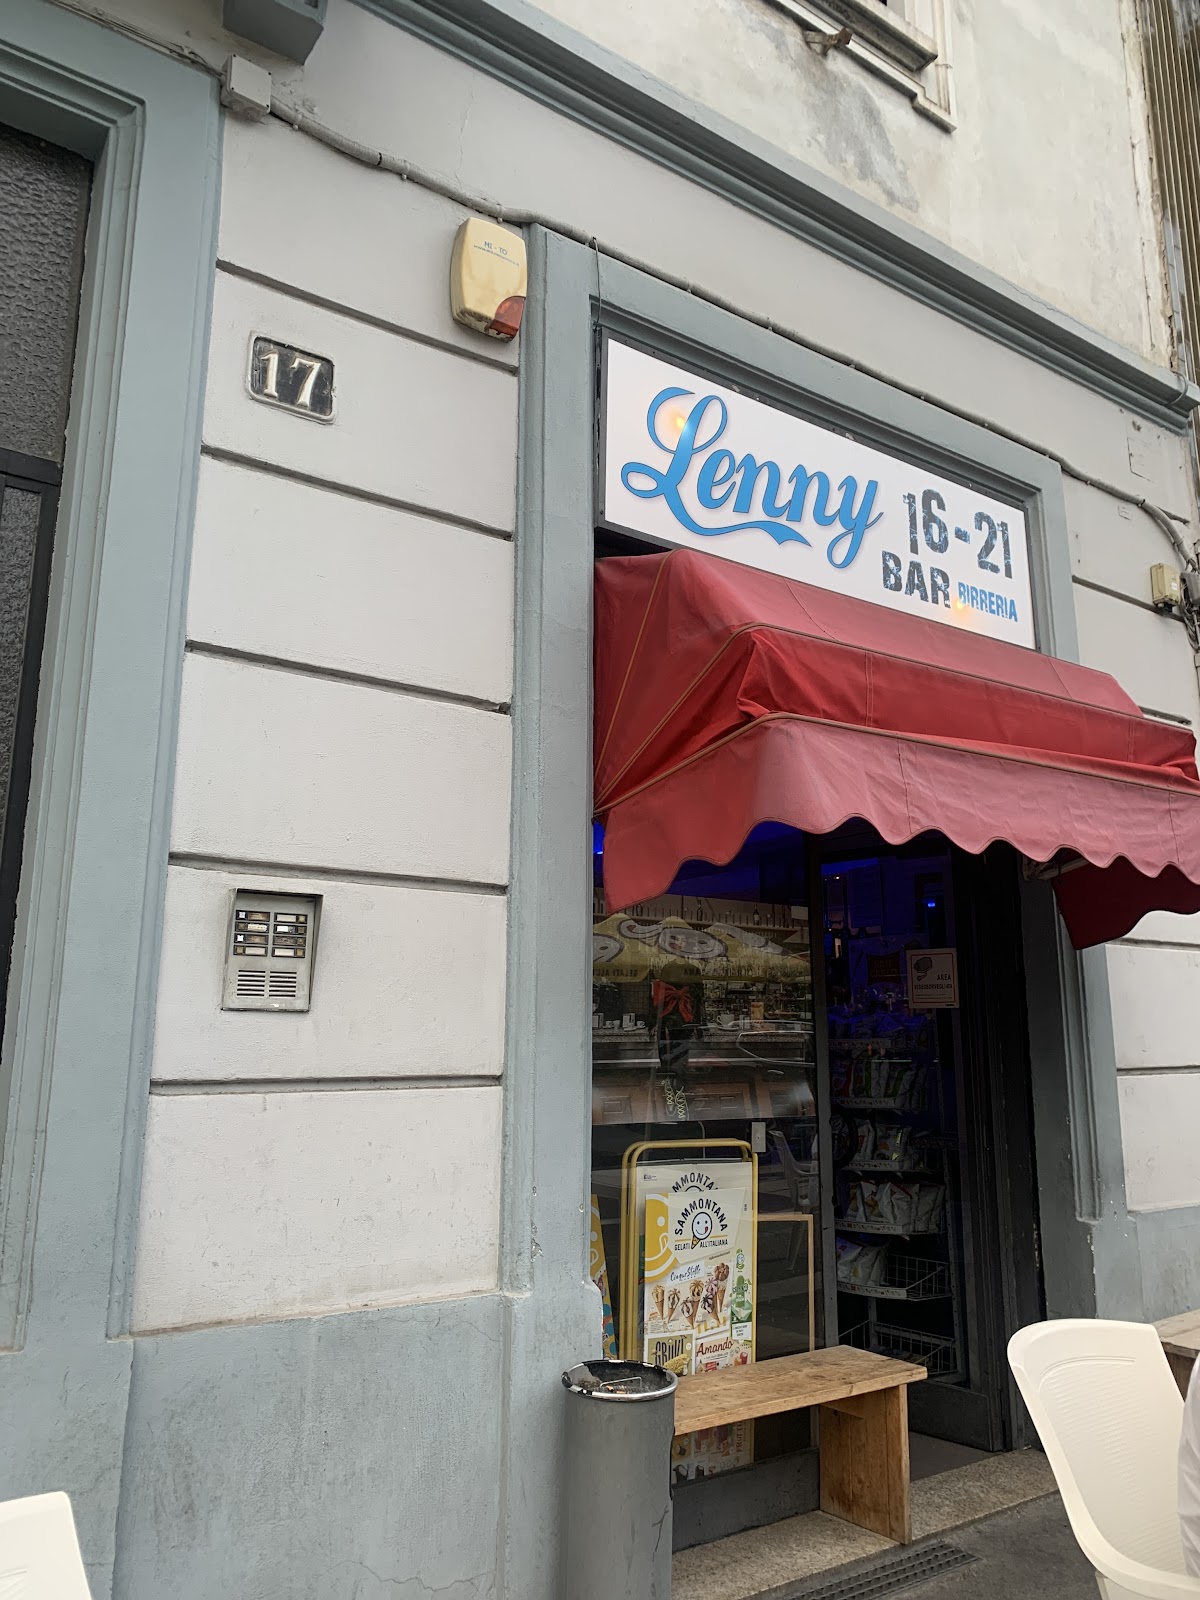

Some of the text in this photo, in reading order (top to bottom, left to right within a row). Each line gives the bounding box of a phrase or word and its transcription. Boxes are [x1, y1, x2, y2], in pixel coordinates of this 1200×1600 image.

[498, 246, 508, 256] TO
[260, 349, 323, 408] 17
[620, 386, 884, 569] Lenny
[902, 488, 1013, 579] 16-21
[881, 550, 1018, 623] BAR BIRRERIA
[936, 973, 952, 981] AREA
[671, 1172, 719, 1193] MMONTA
[674, 1198, 728, 1235] SAMMONTANA
[674, 1242, 690, 1251] GELATI
[695, 1336, 735, 1357] Amando
